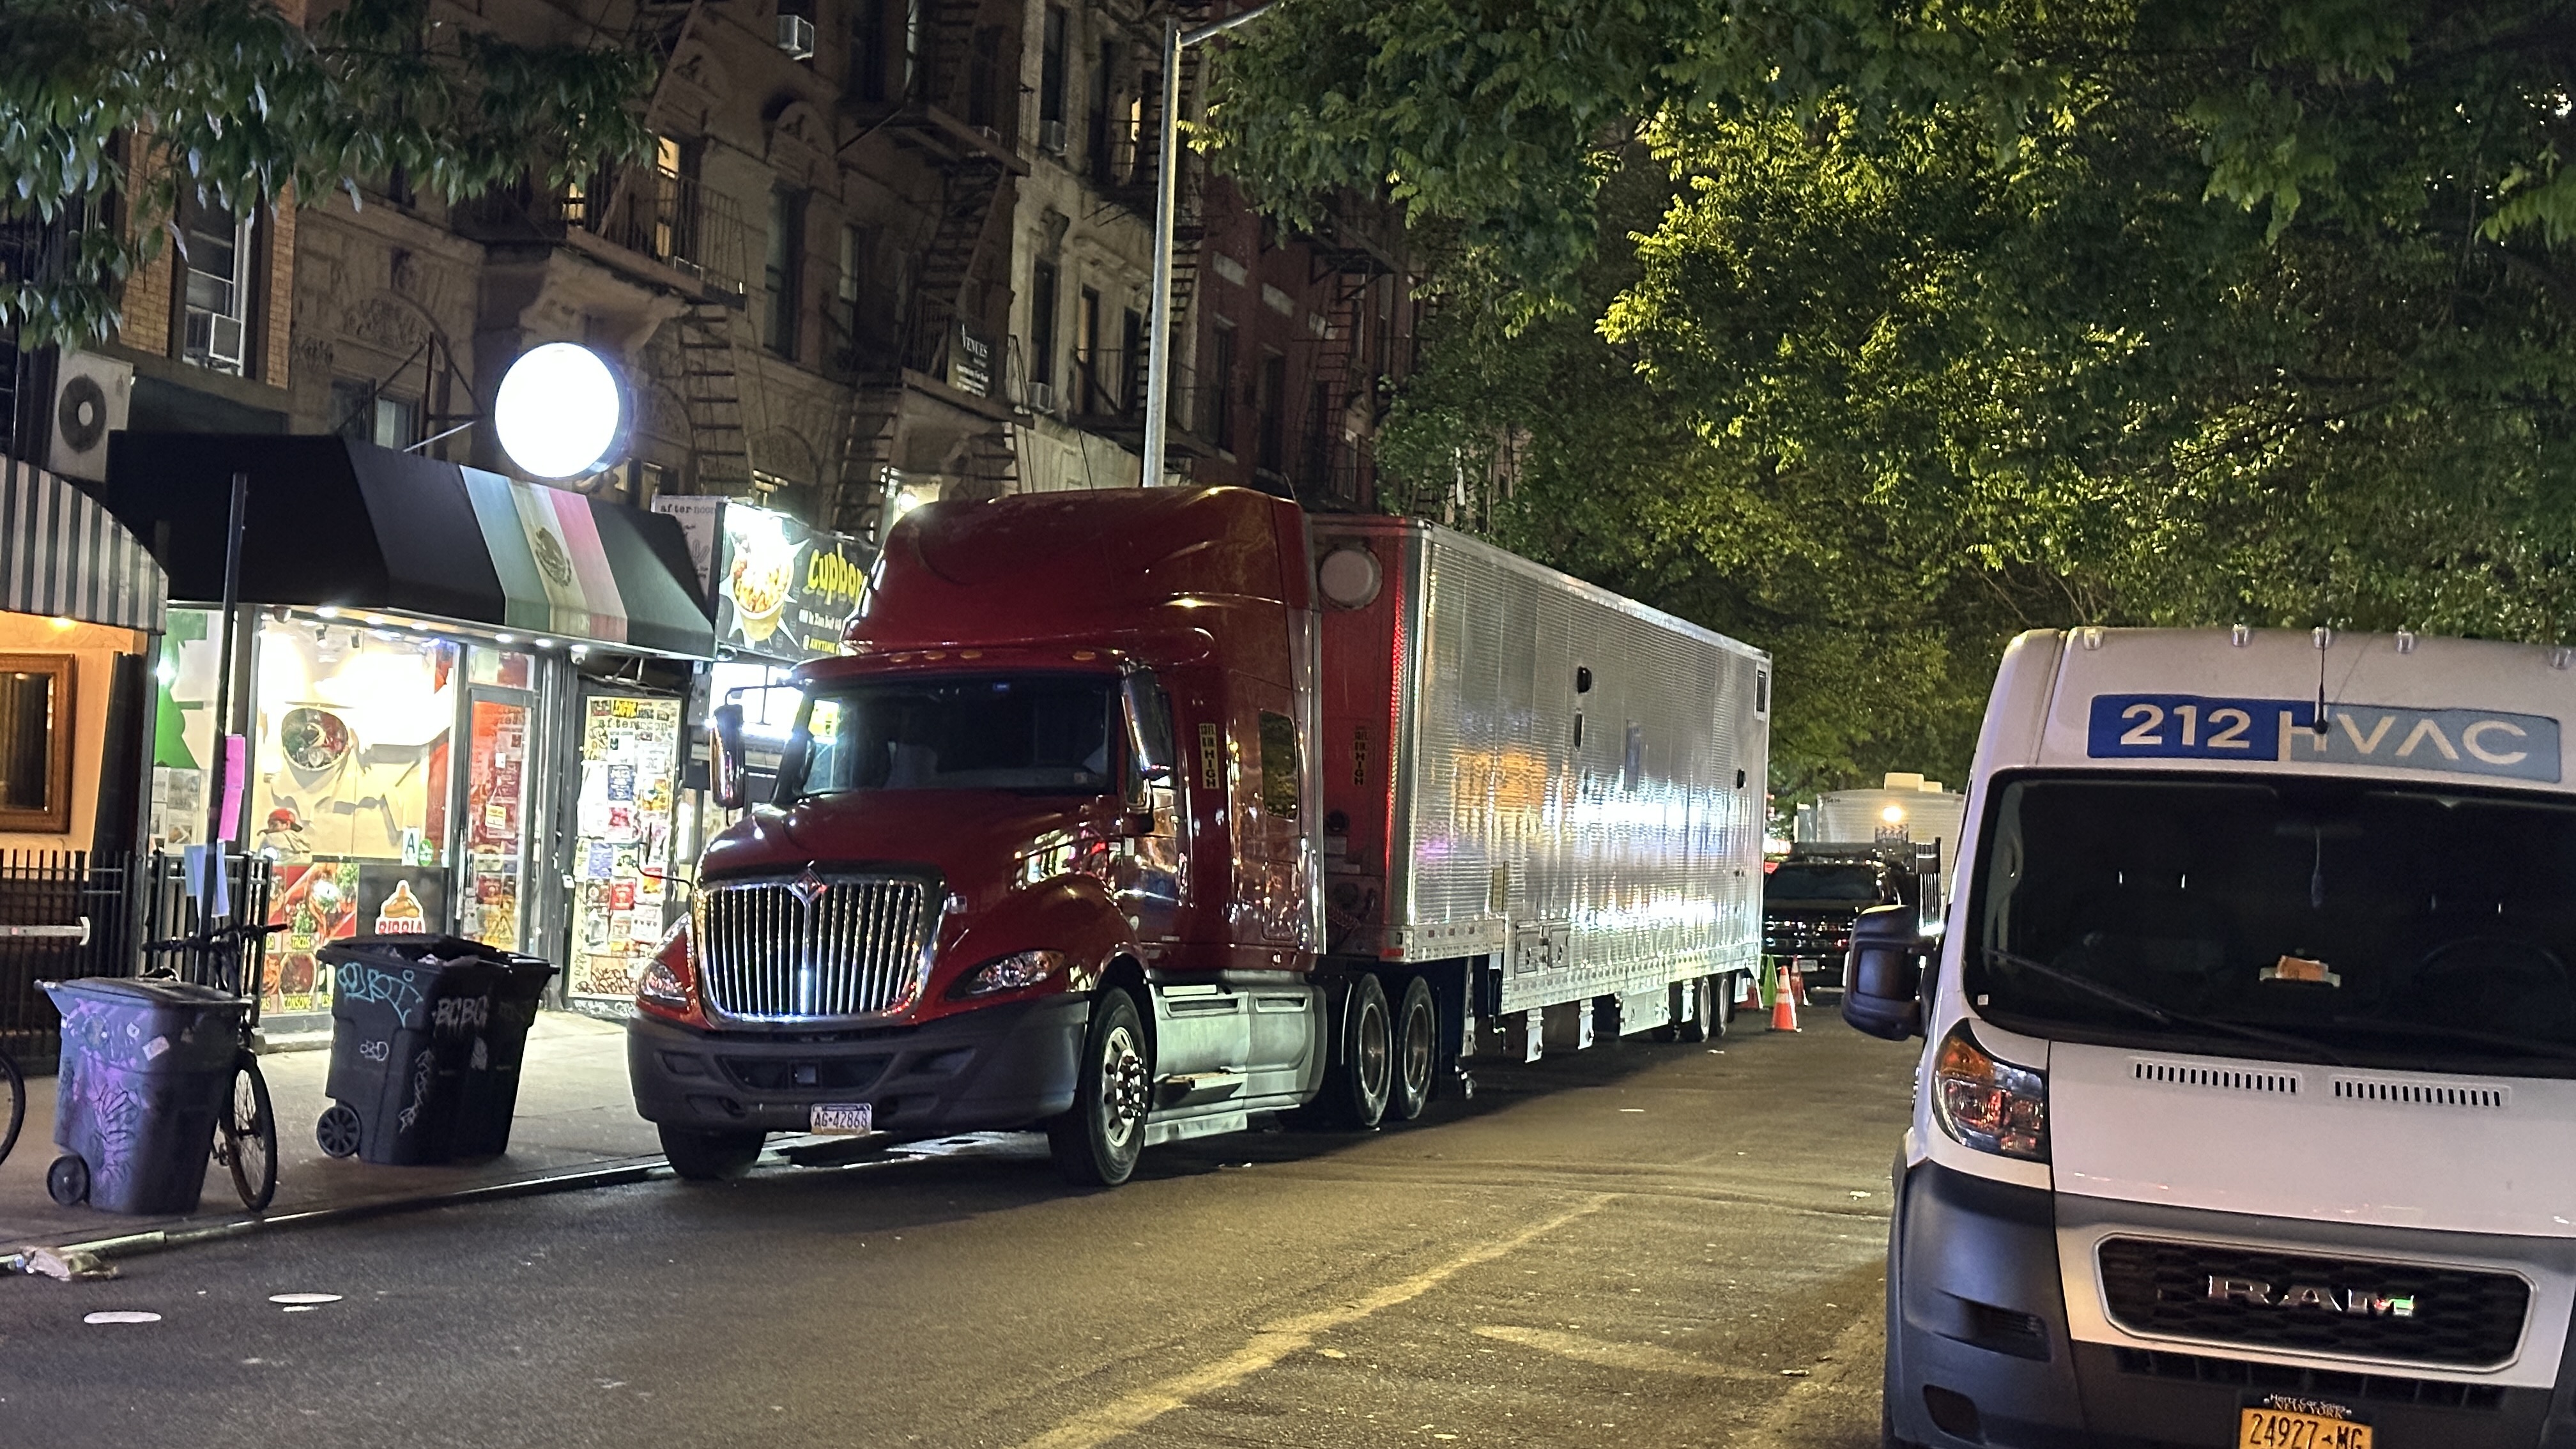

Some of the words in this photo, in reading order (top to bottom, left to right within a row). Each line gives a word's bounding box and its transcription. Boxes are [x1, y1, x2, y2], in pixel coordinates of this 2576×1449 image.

[2119, 703, 2251, 749] 212
[2278, 710, 2529, 765] HVAC
[1204, 749, 1216, 788] HIGH
[1354, 753, 1365, 786] HIGH
[405, 832, 415, 854] A
[291, 935, 310, 949] TACOS
[283, 995, 312, 1010] CONSOME
[2207, 1274, 2415, 1317] RAM
[2273, 1402, 2304, 1413] NEW
[2310, 1406, 2343, 1419] YORK
[2299, 1398, 2317, 1407] Car
